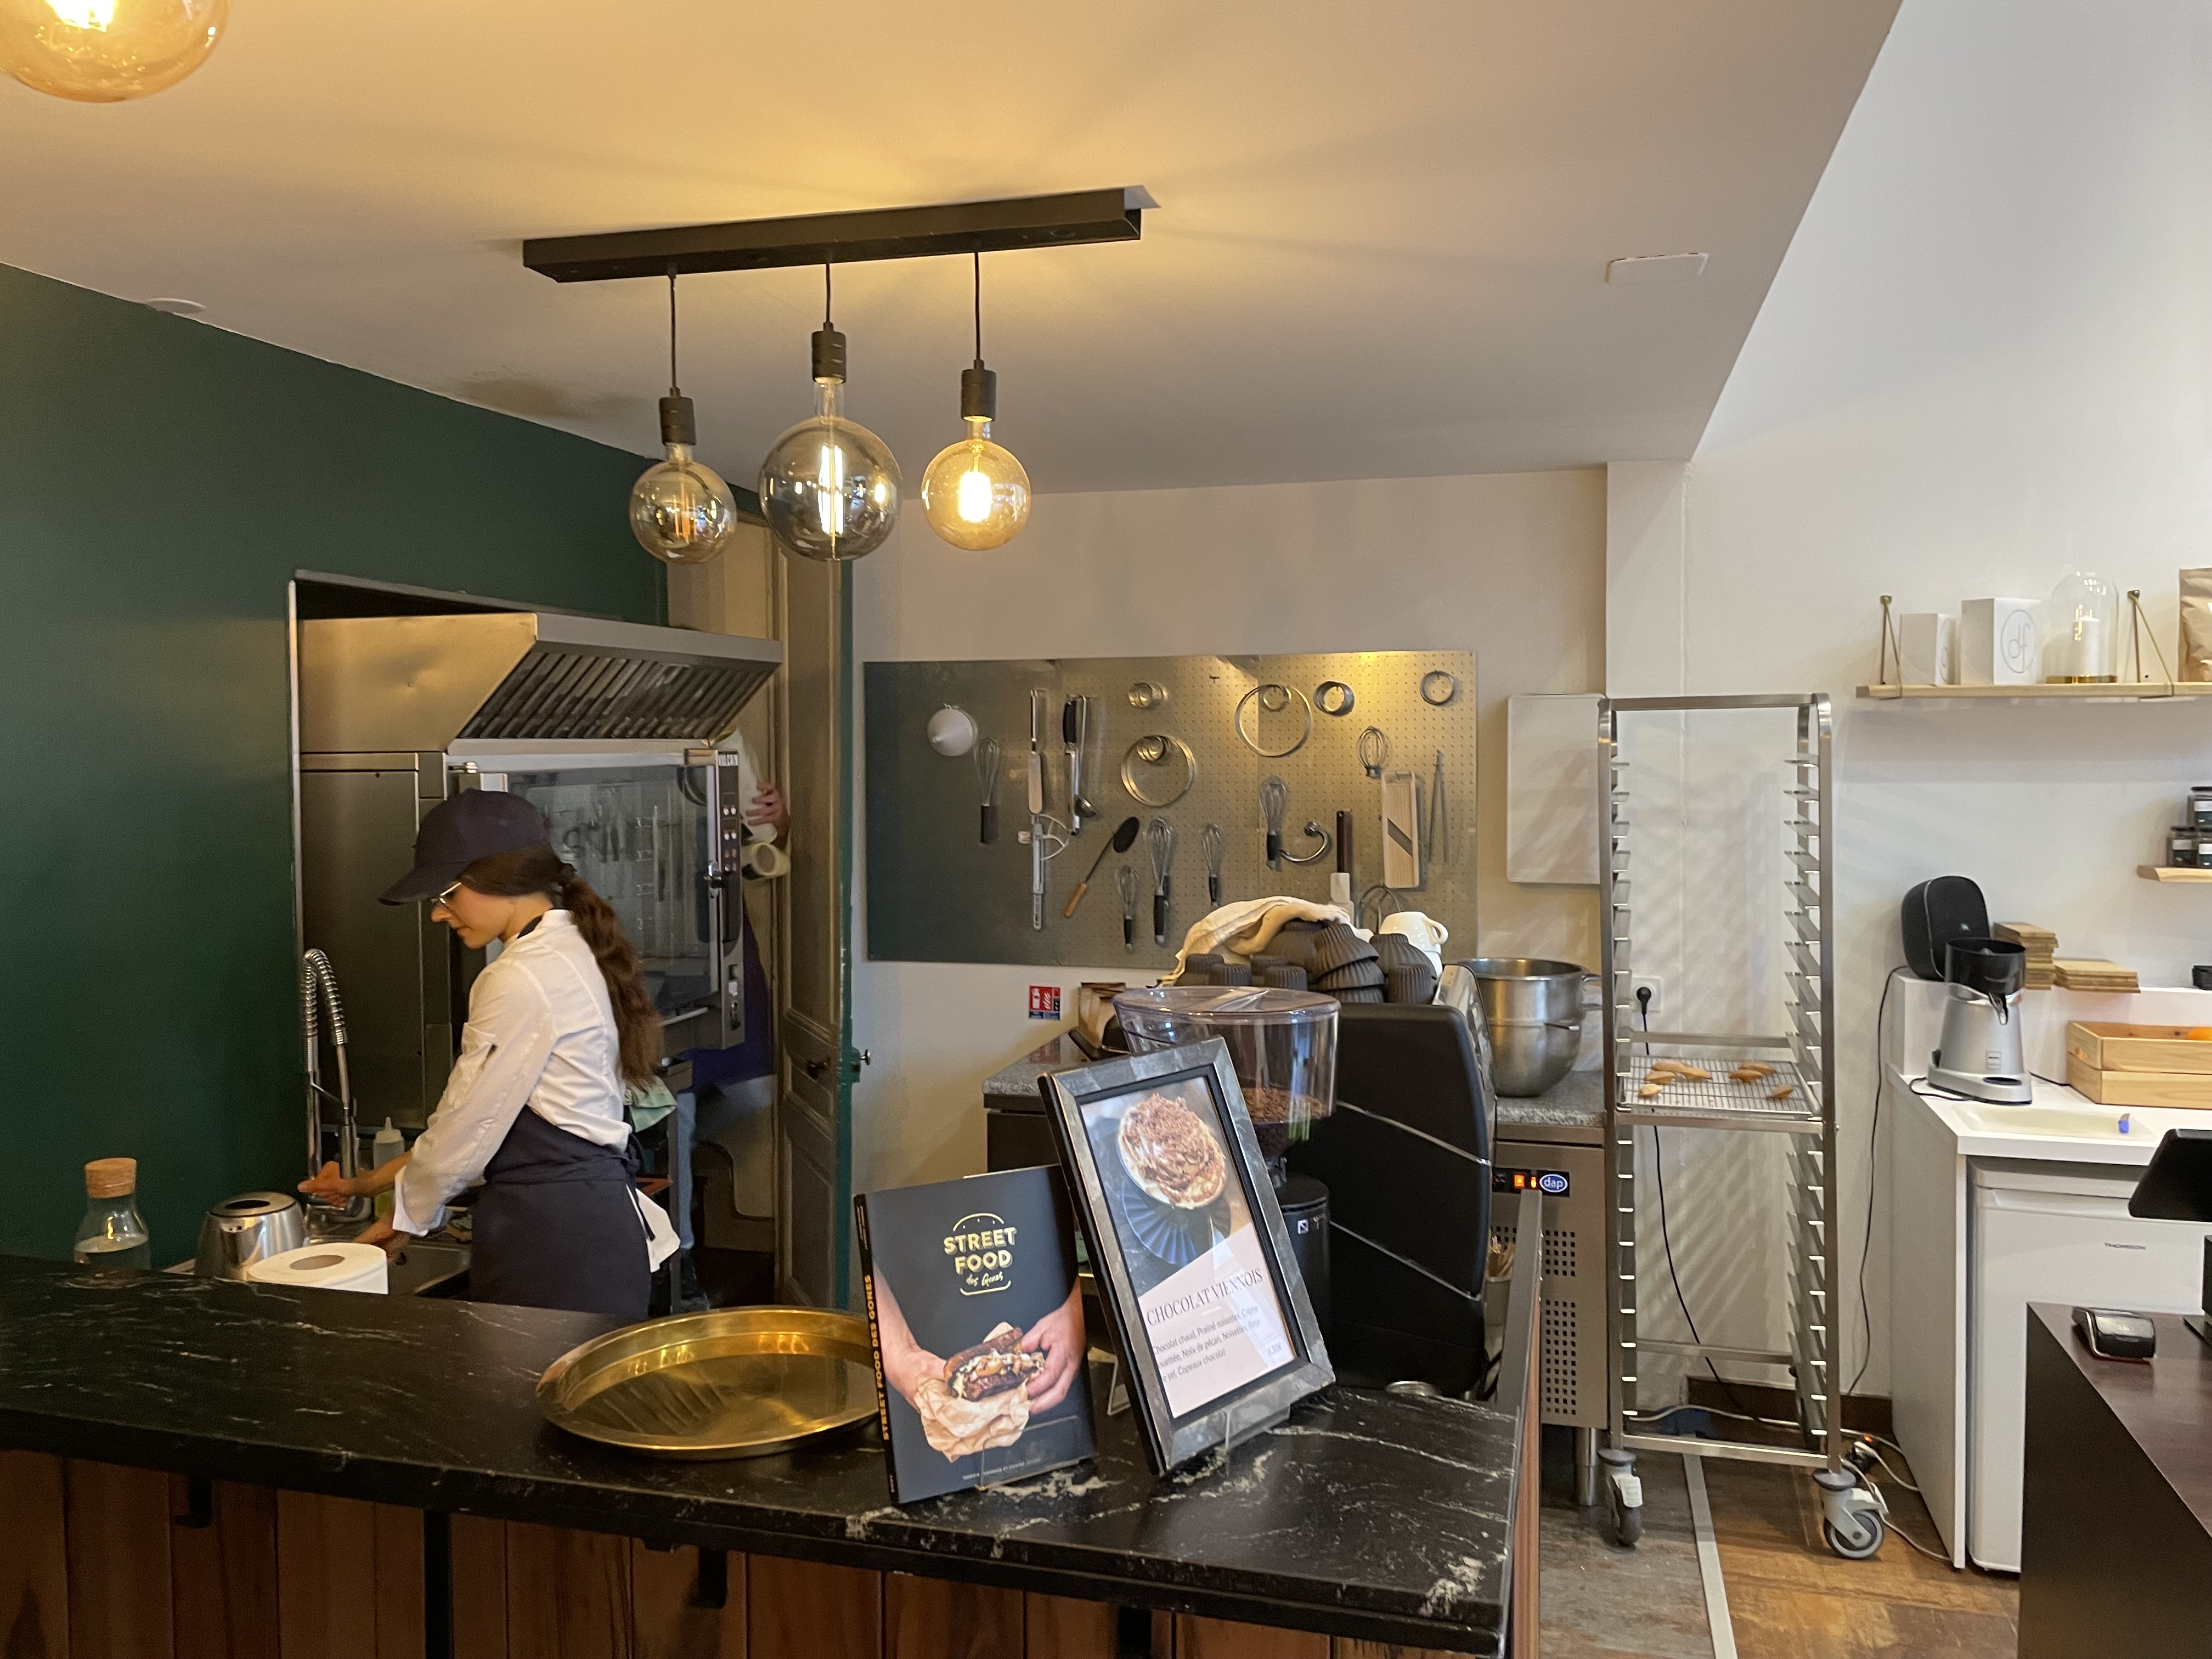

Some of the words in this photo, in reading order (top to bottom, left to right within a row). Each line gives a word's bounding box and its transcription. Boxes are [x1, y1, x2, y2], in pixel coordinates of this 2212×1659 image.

[1544, 1177, 1563, 1189] dap
[944, 1227, 1017, 1255] STREET
[955, 1250, 1013, 1275] FOOD
[865, 1274, 876, 1320] GONES
[1147, 1288, 1210, 1326] CHOCOLAT
[1211, 1268, 1263, 1299] VIENNOIS
[870, 1323, 878, 1347] DES
[1197, 1342, 1204, 1352] de
[873, 1350, 883, 1388] FOOD
[878, 1391, 889, 1440] STREET
